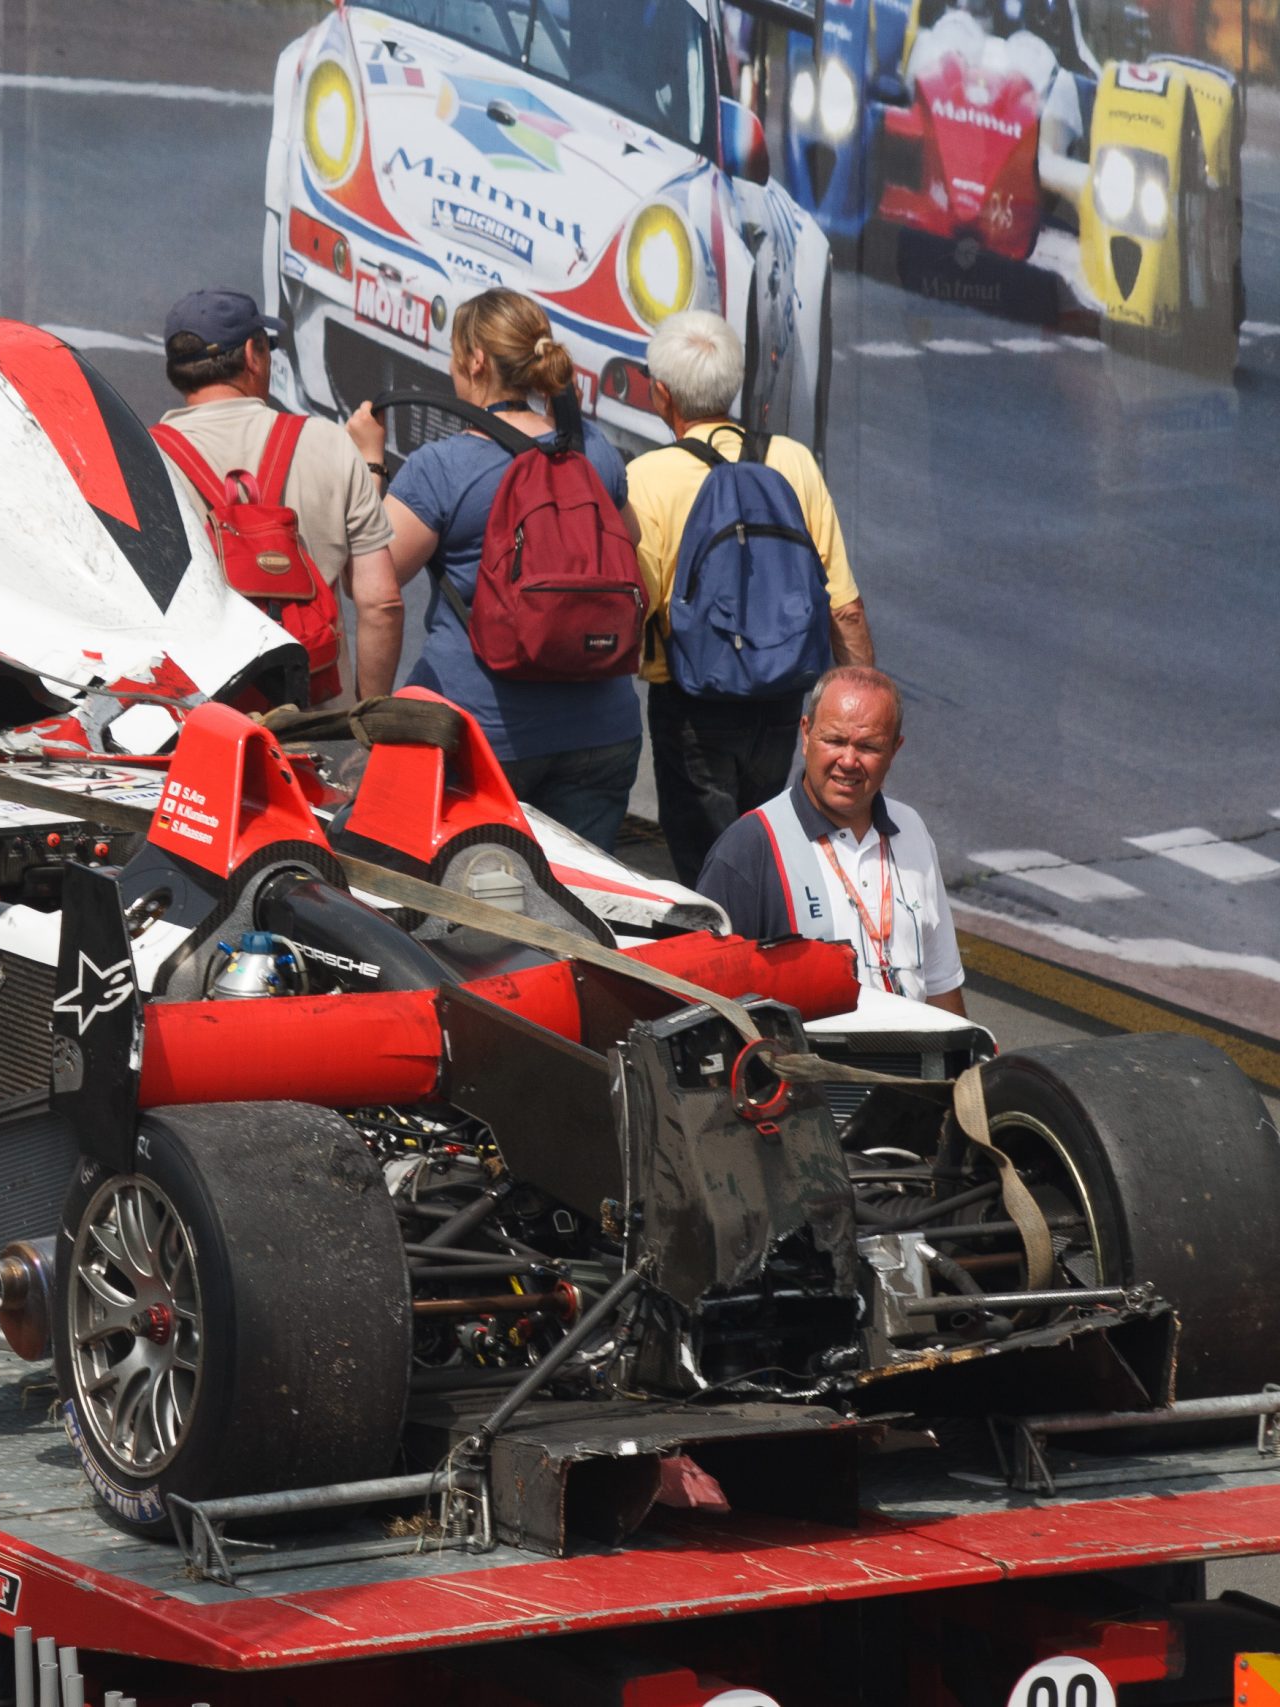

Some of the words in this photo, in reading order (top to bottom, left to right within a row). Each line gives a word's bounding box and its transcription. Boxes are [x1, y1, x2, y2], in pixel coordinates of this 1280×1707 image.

[931, 97, 1022, 139] Matmut
[388, 147, 587, 252] Matmut
[455, 206, 531, 256] MICHELIN
[446, 251, 504, 284] IMSA
[357, 277, 428, 344] MOTUL
